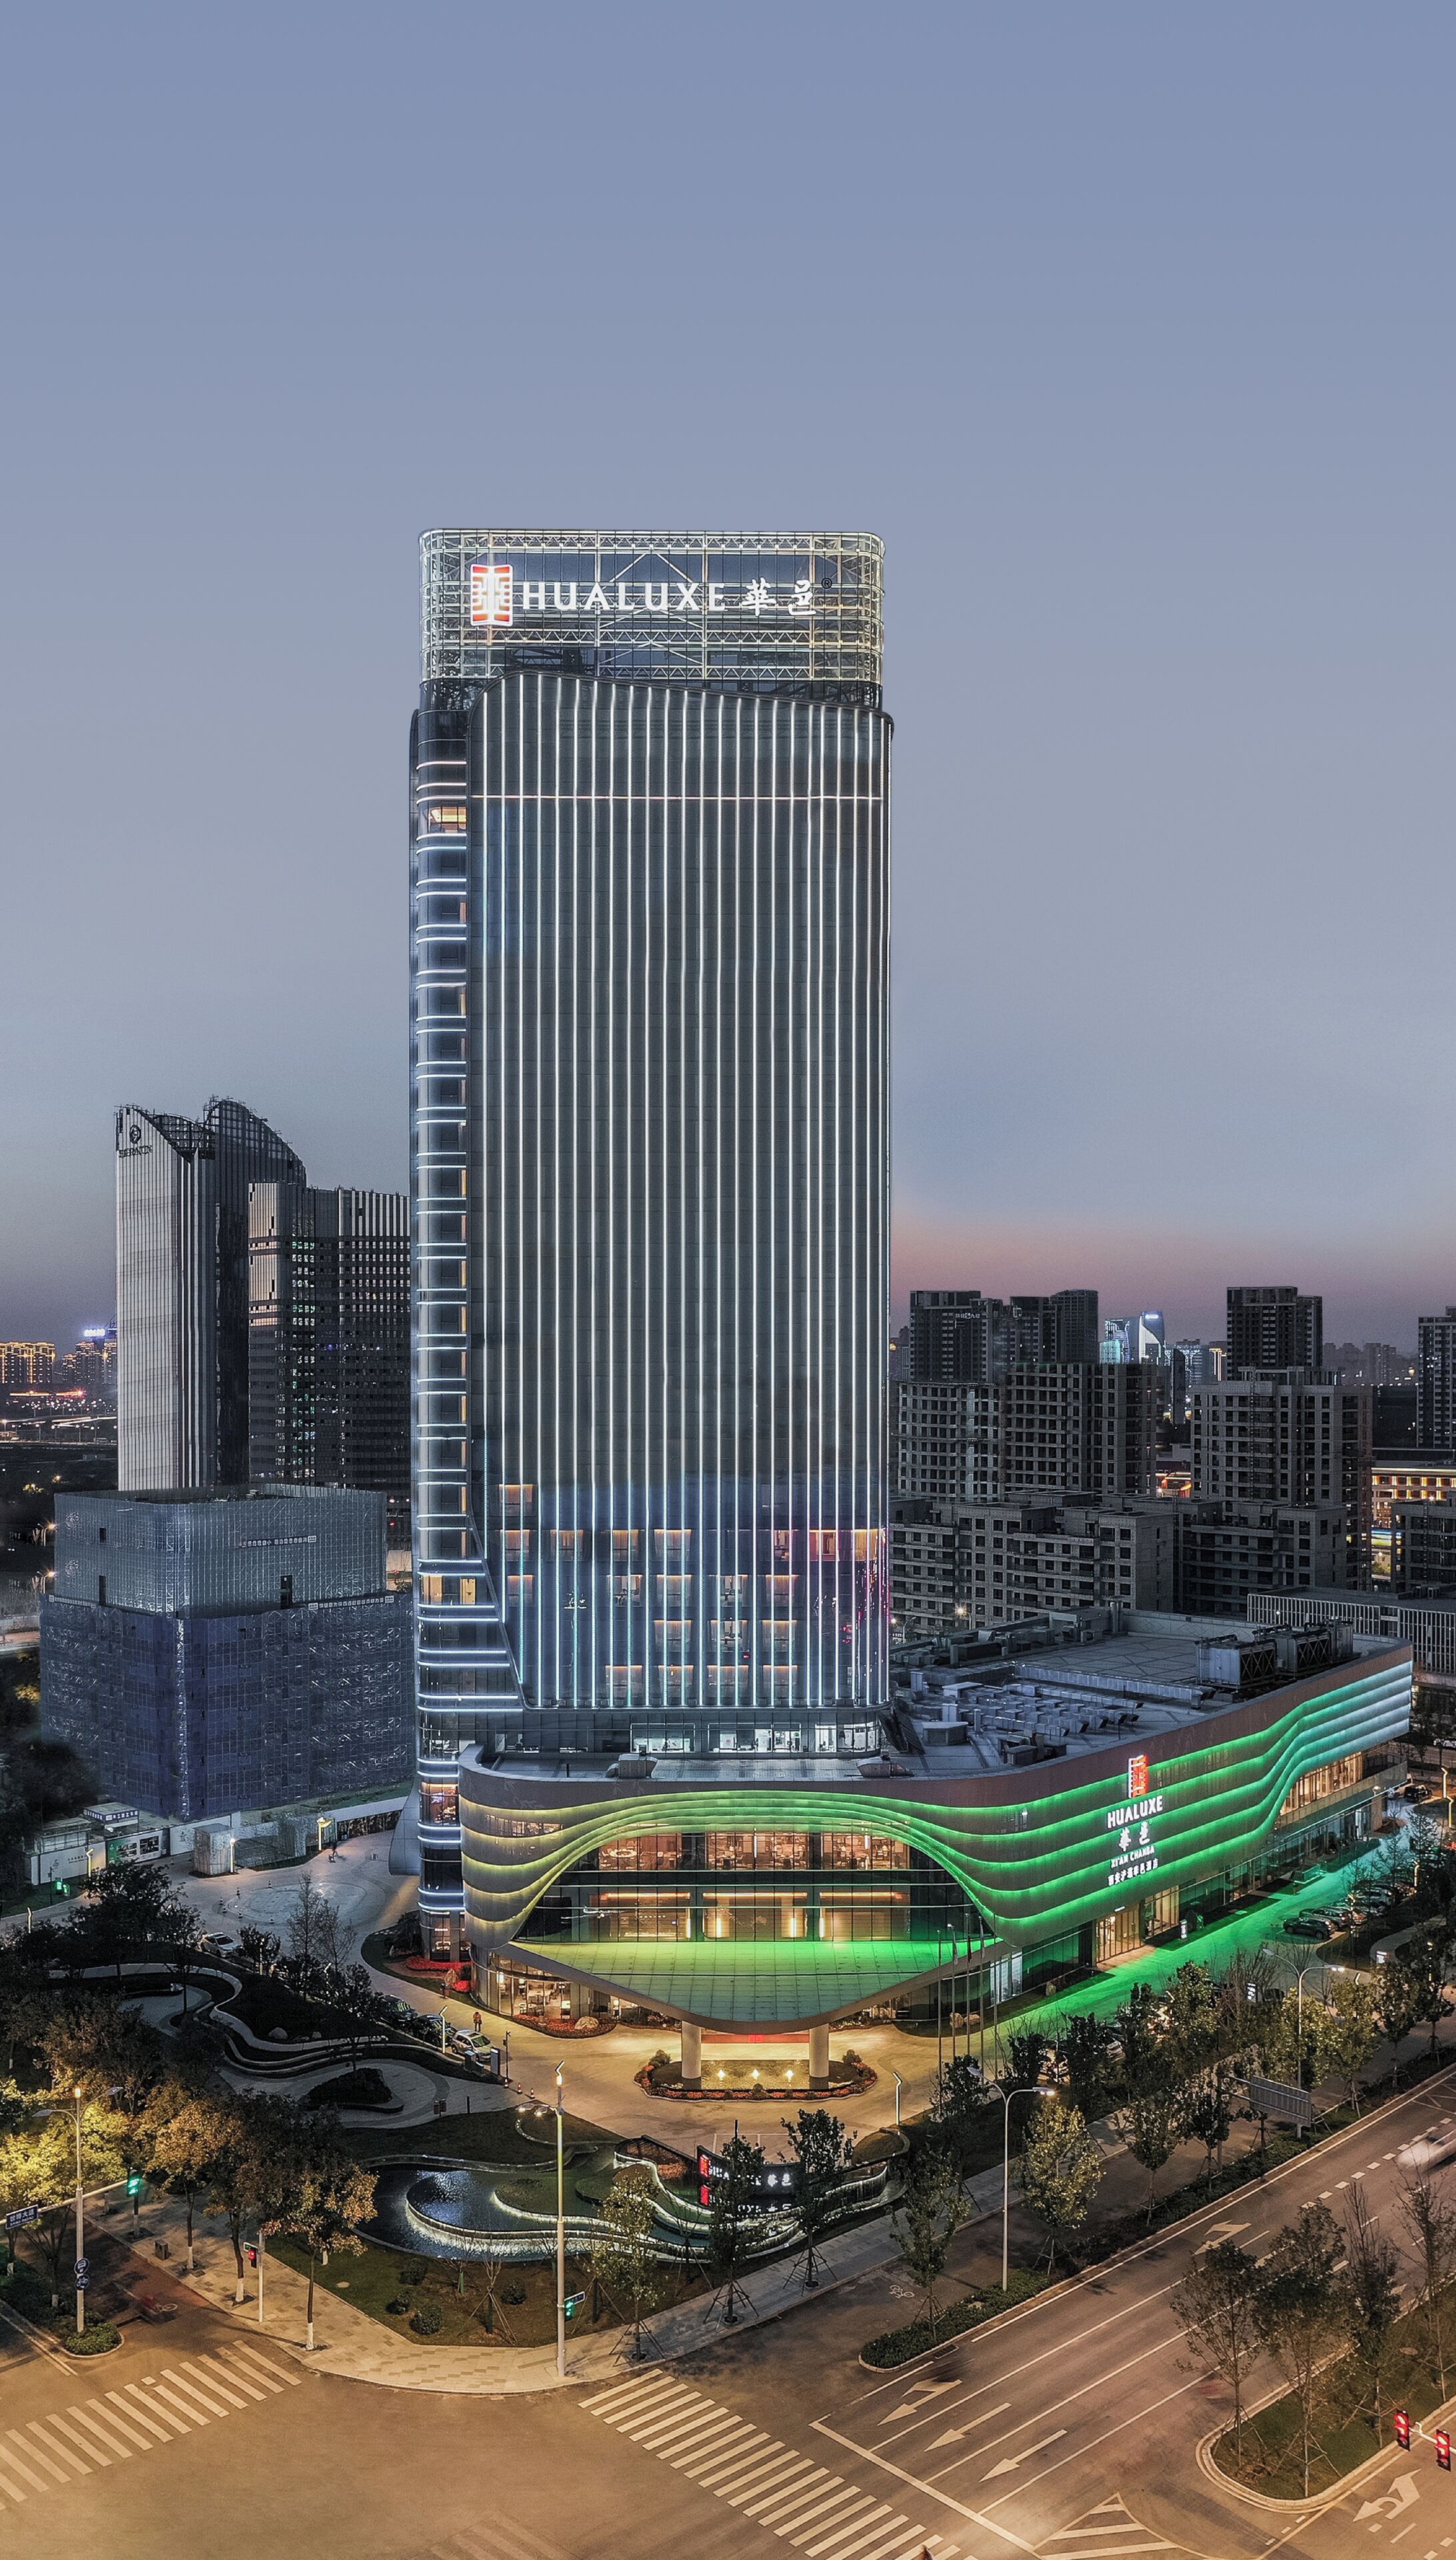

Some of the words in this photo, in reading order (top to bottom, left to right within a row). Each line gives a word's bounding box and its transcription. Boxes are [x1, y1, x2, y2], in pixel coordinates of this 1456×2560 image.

[523, 582, 725, 611] HUALUXE
[742, 577, 817, 616] 華邑
[1107, 1795, 1163, 1829] HUALUXE
